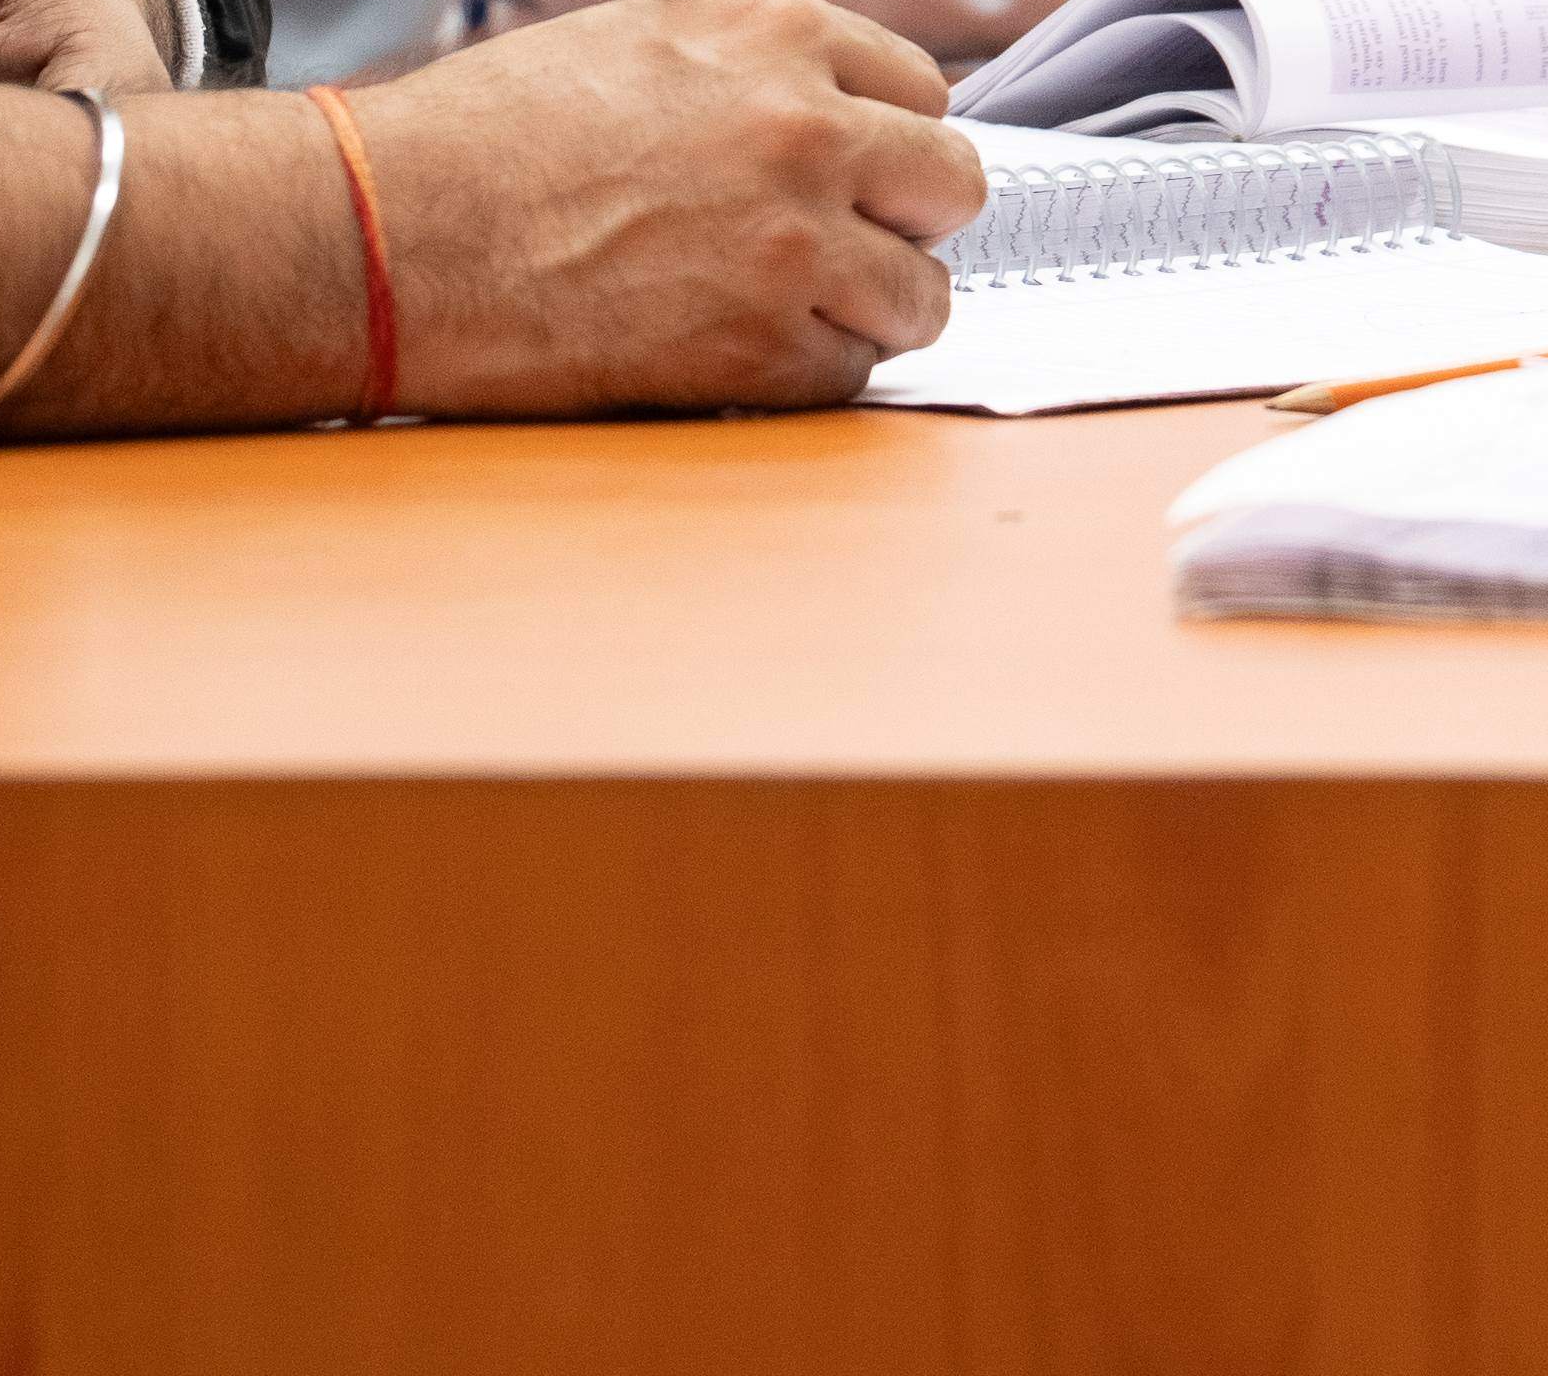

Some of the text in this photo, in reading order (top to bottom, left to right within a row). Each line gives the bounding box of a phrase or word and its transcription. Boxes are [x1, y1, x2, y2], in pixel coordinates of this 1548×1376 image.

[1355, 19, 1372, 73] parabola,
[1370, 19, 1383, 44] light
[1498, 27, 1508, 64] drawn
[1346, 23, 1360, 87] bisects the
[1375, 50, 1384, 70] ray
[1426, 48, 1436, 84] which
[1376, 77, 1386, 86] is
[1438, 58, 1448, 83] then
